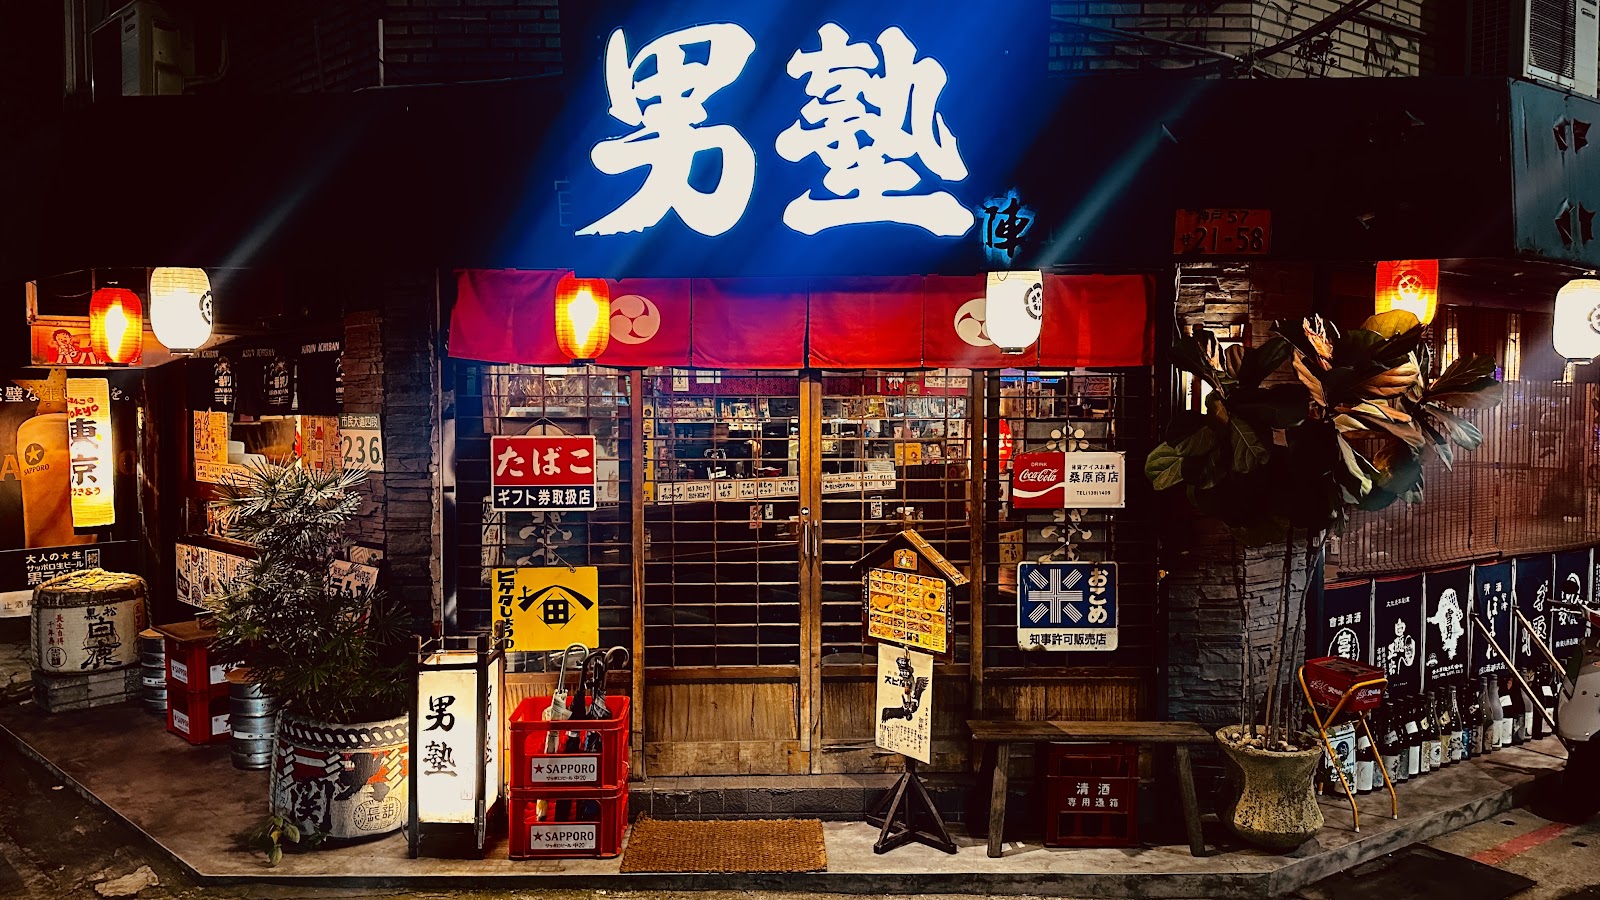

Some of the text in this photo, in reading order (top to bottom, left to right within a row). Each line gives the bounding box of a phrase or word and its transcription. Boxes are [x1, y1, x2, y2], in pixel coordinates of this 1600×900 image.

[575, 21, 975, 237] 男塾
[983, 197, 1031, 258] 陣
[341, 415, 378, 429] 市民大道四段
[69, 418, 99, 486] 東京
[343, 435, 380, 464] 236
[496, 445, 592, 477] たばこ
[23, 463, 50, 476] SAPPORO
[1019, 468, 1059, 482] Coca-Cola
[1069, 472, 1119, 483] 桑原商店
[497, 488, 591, 506] ギフト券取扱店
[26, 560, 84, 573] サッポロ生ビール
[1087, 567, 1109, 624] おこめ
[80, 616, 123, 670] 白鹿
[1029, 633, 1107, 646] 知事許可販売店
[422, 694, 458, 778] 男塾
[546, 763, 595, 774] SAPPORO
[1076, 782, 1111, 796] 清酒
[544, 831, 594, 842] SAPPORO
